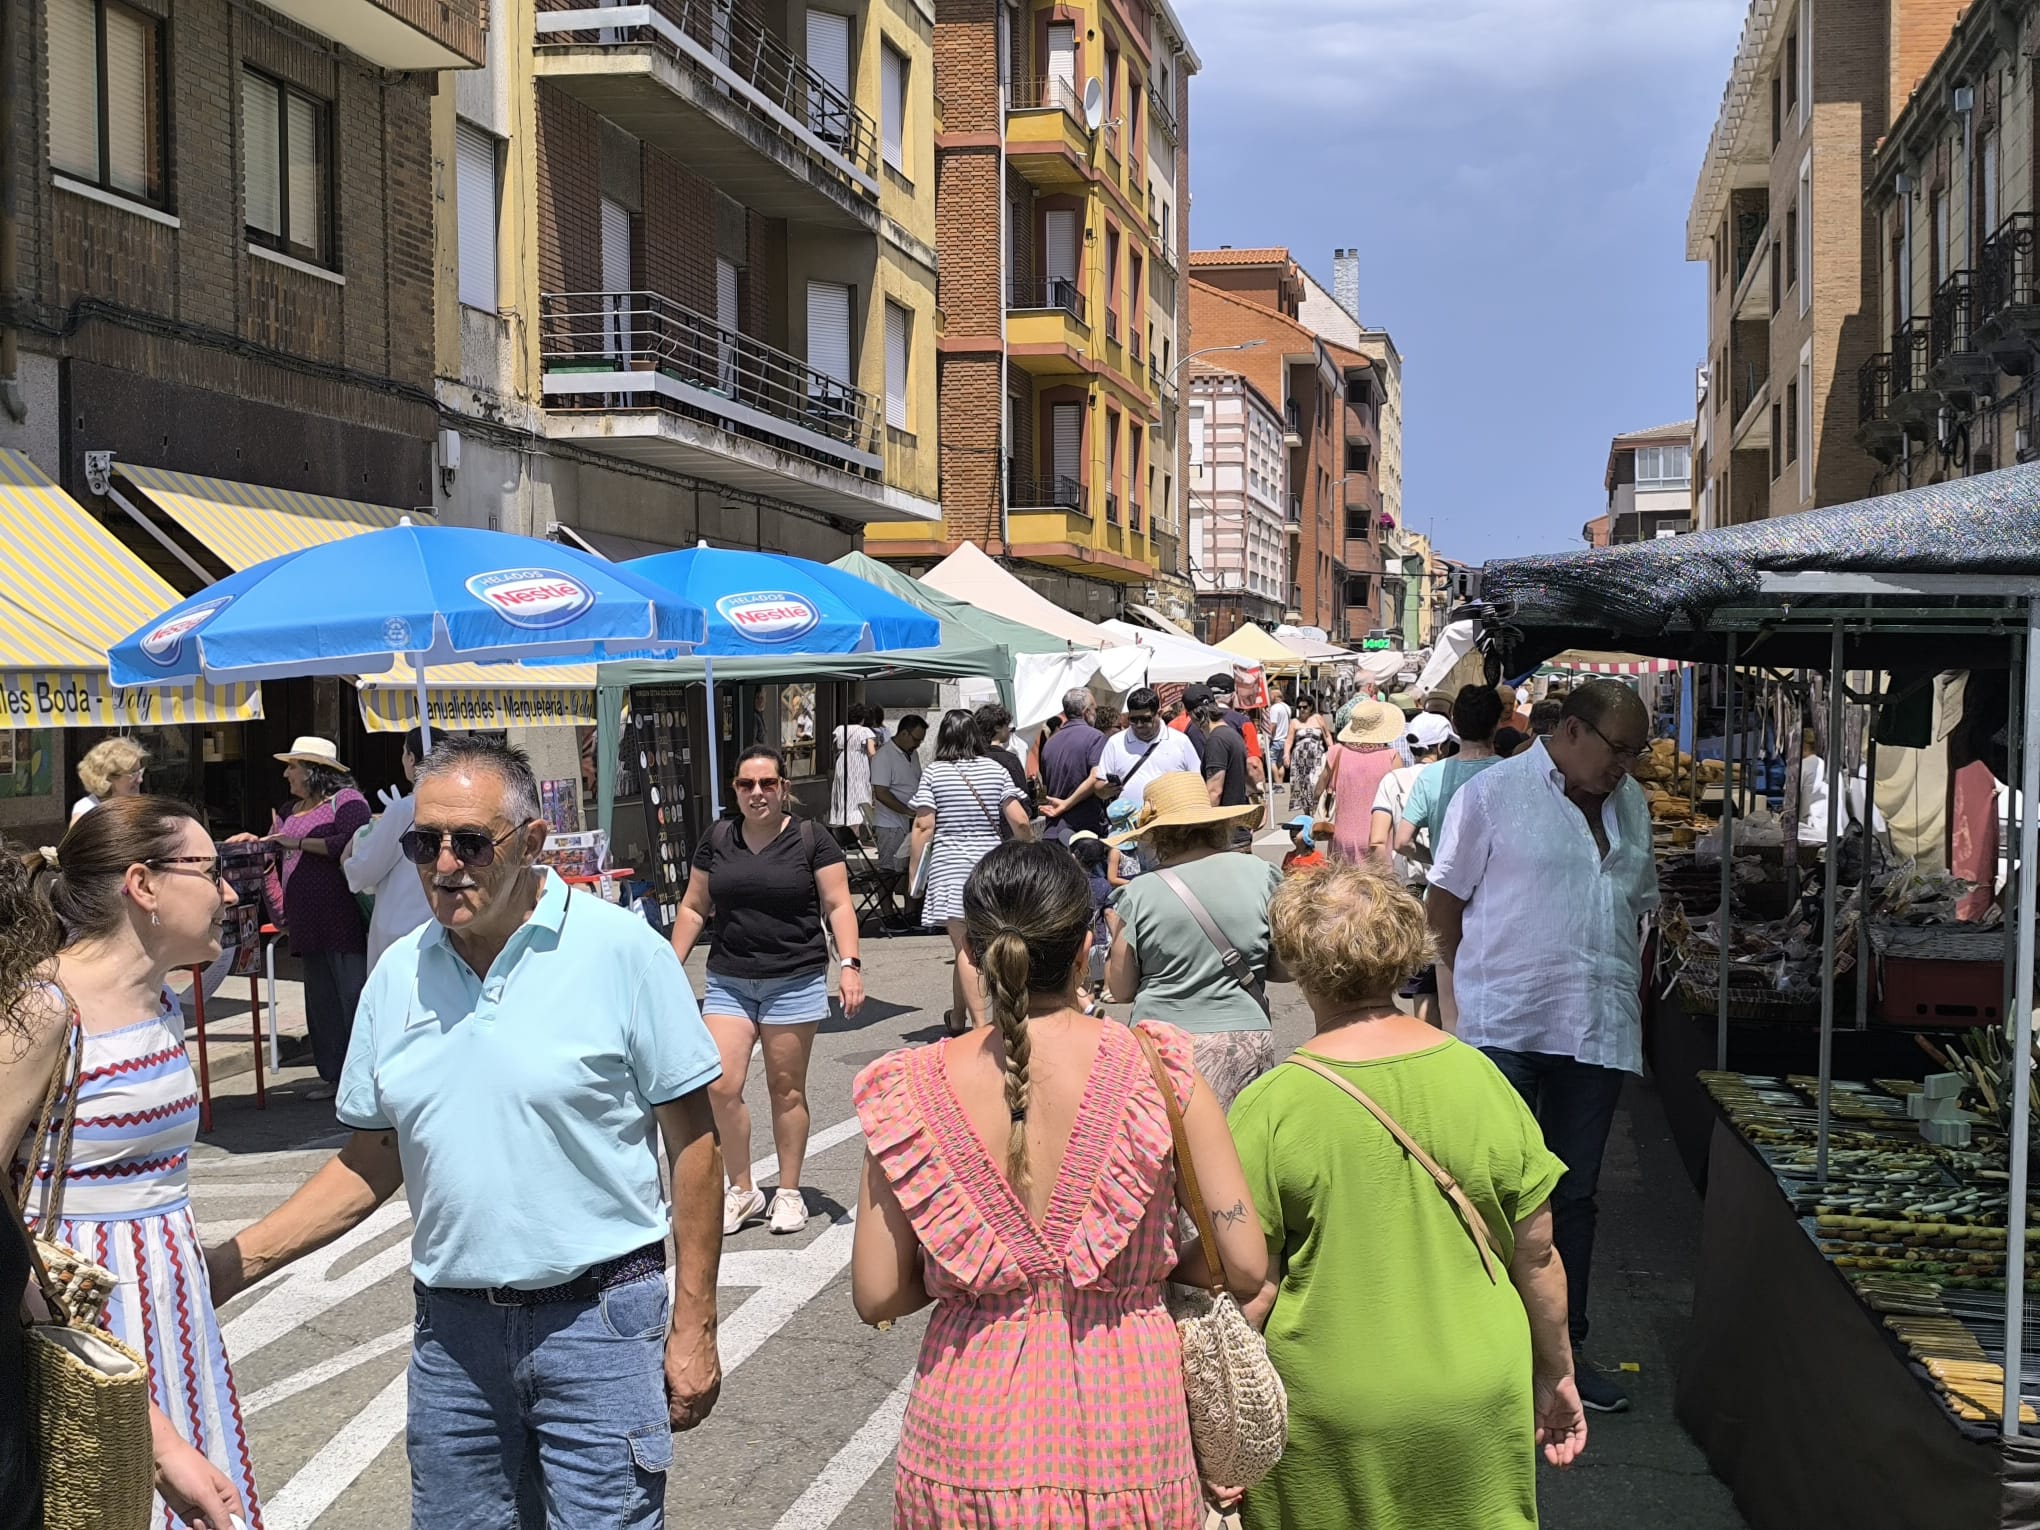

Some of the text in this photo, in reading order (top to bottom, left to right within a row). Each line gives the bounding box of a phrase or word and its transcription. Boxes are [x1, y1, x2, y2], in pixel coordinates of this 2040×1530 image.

[481, 570, 545, 586] HELADOS
[729, 593, 786, 606] HELADOS
[36, 681, 91, 713] Boda
